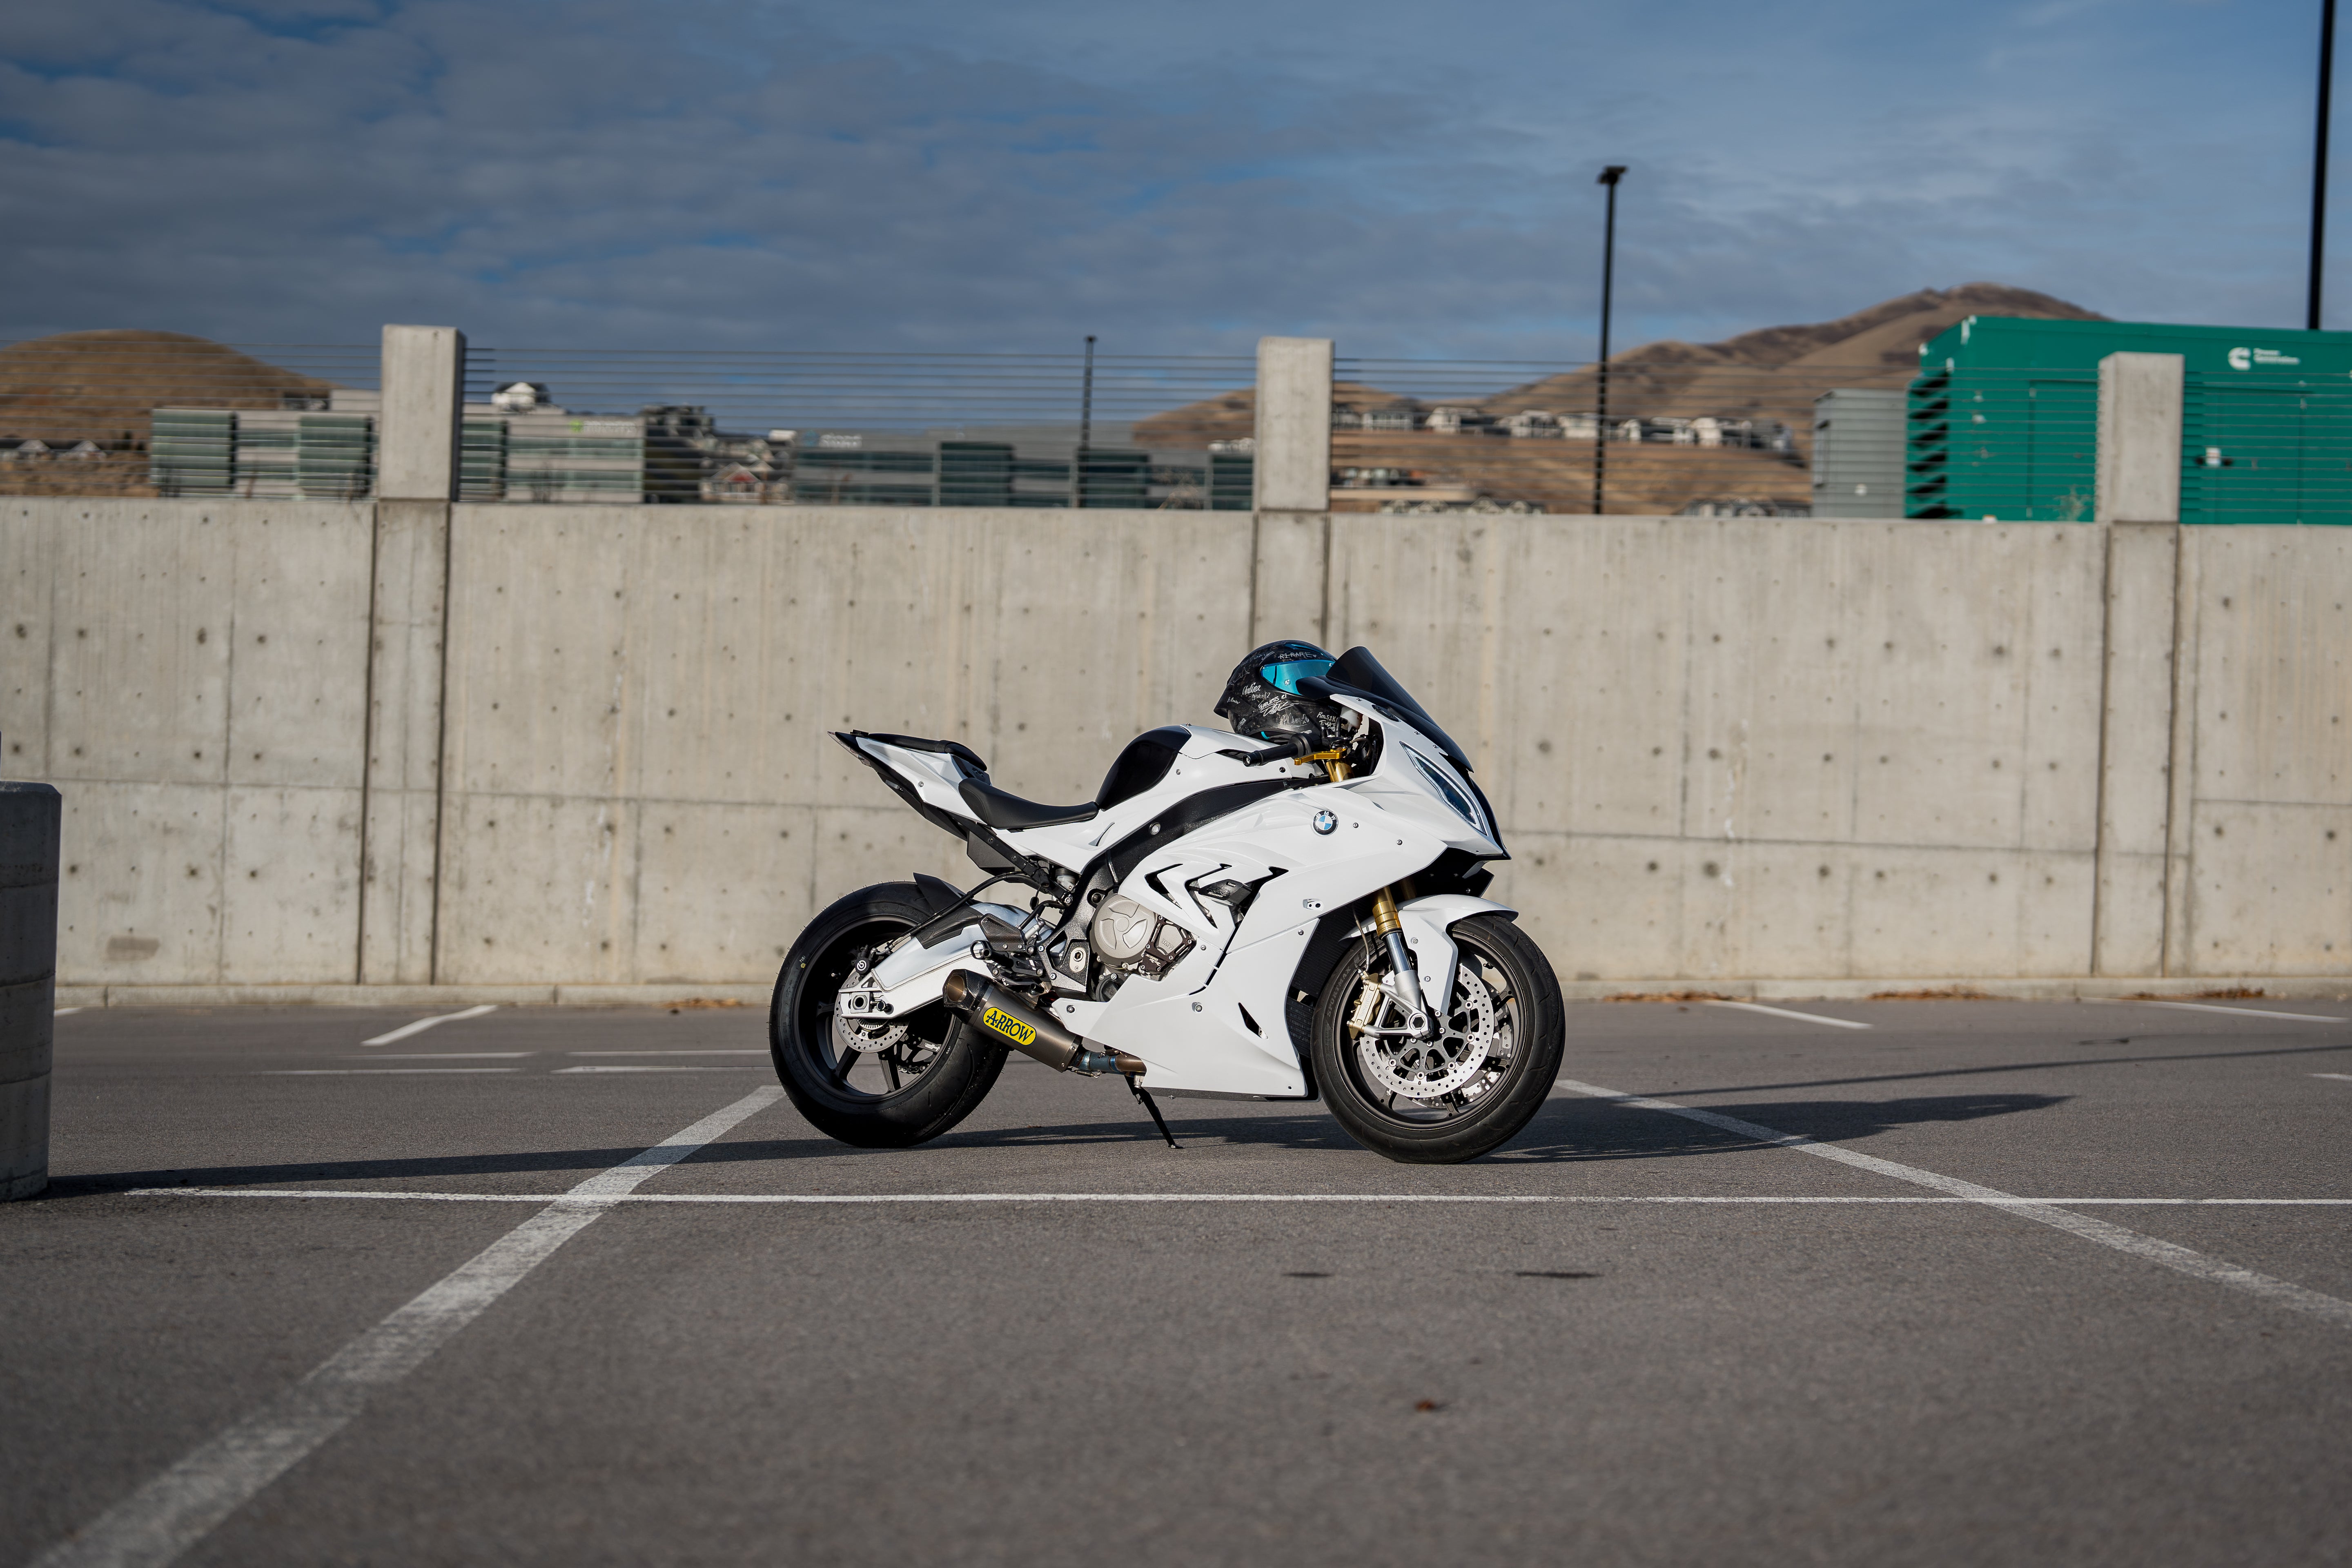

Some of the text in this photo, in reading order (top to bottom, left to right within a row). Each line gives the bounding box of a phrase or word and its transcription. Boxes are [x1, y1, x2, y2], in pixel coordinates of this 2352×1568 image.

[1316, 811, 1336, 820] BMW
[1160, 938, 1175, 951] BMW
[1327, 965, 1352, 1017] SPORTMAX
[985, 1010, 1034, 1042] ARROW
